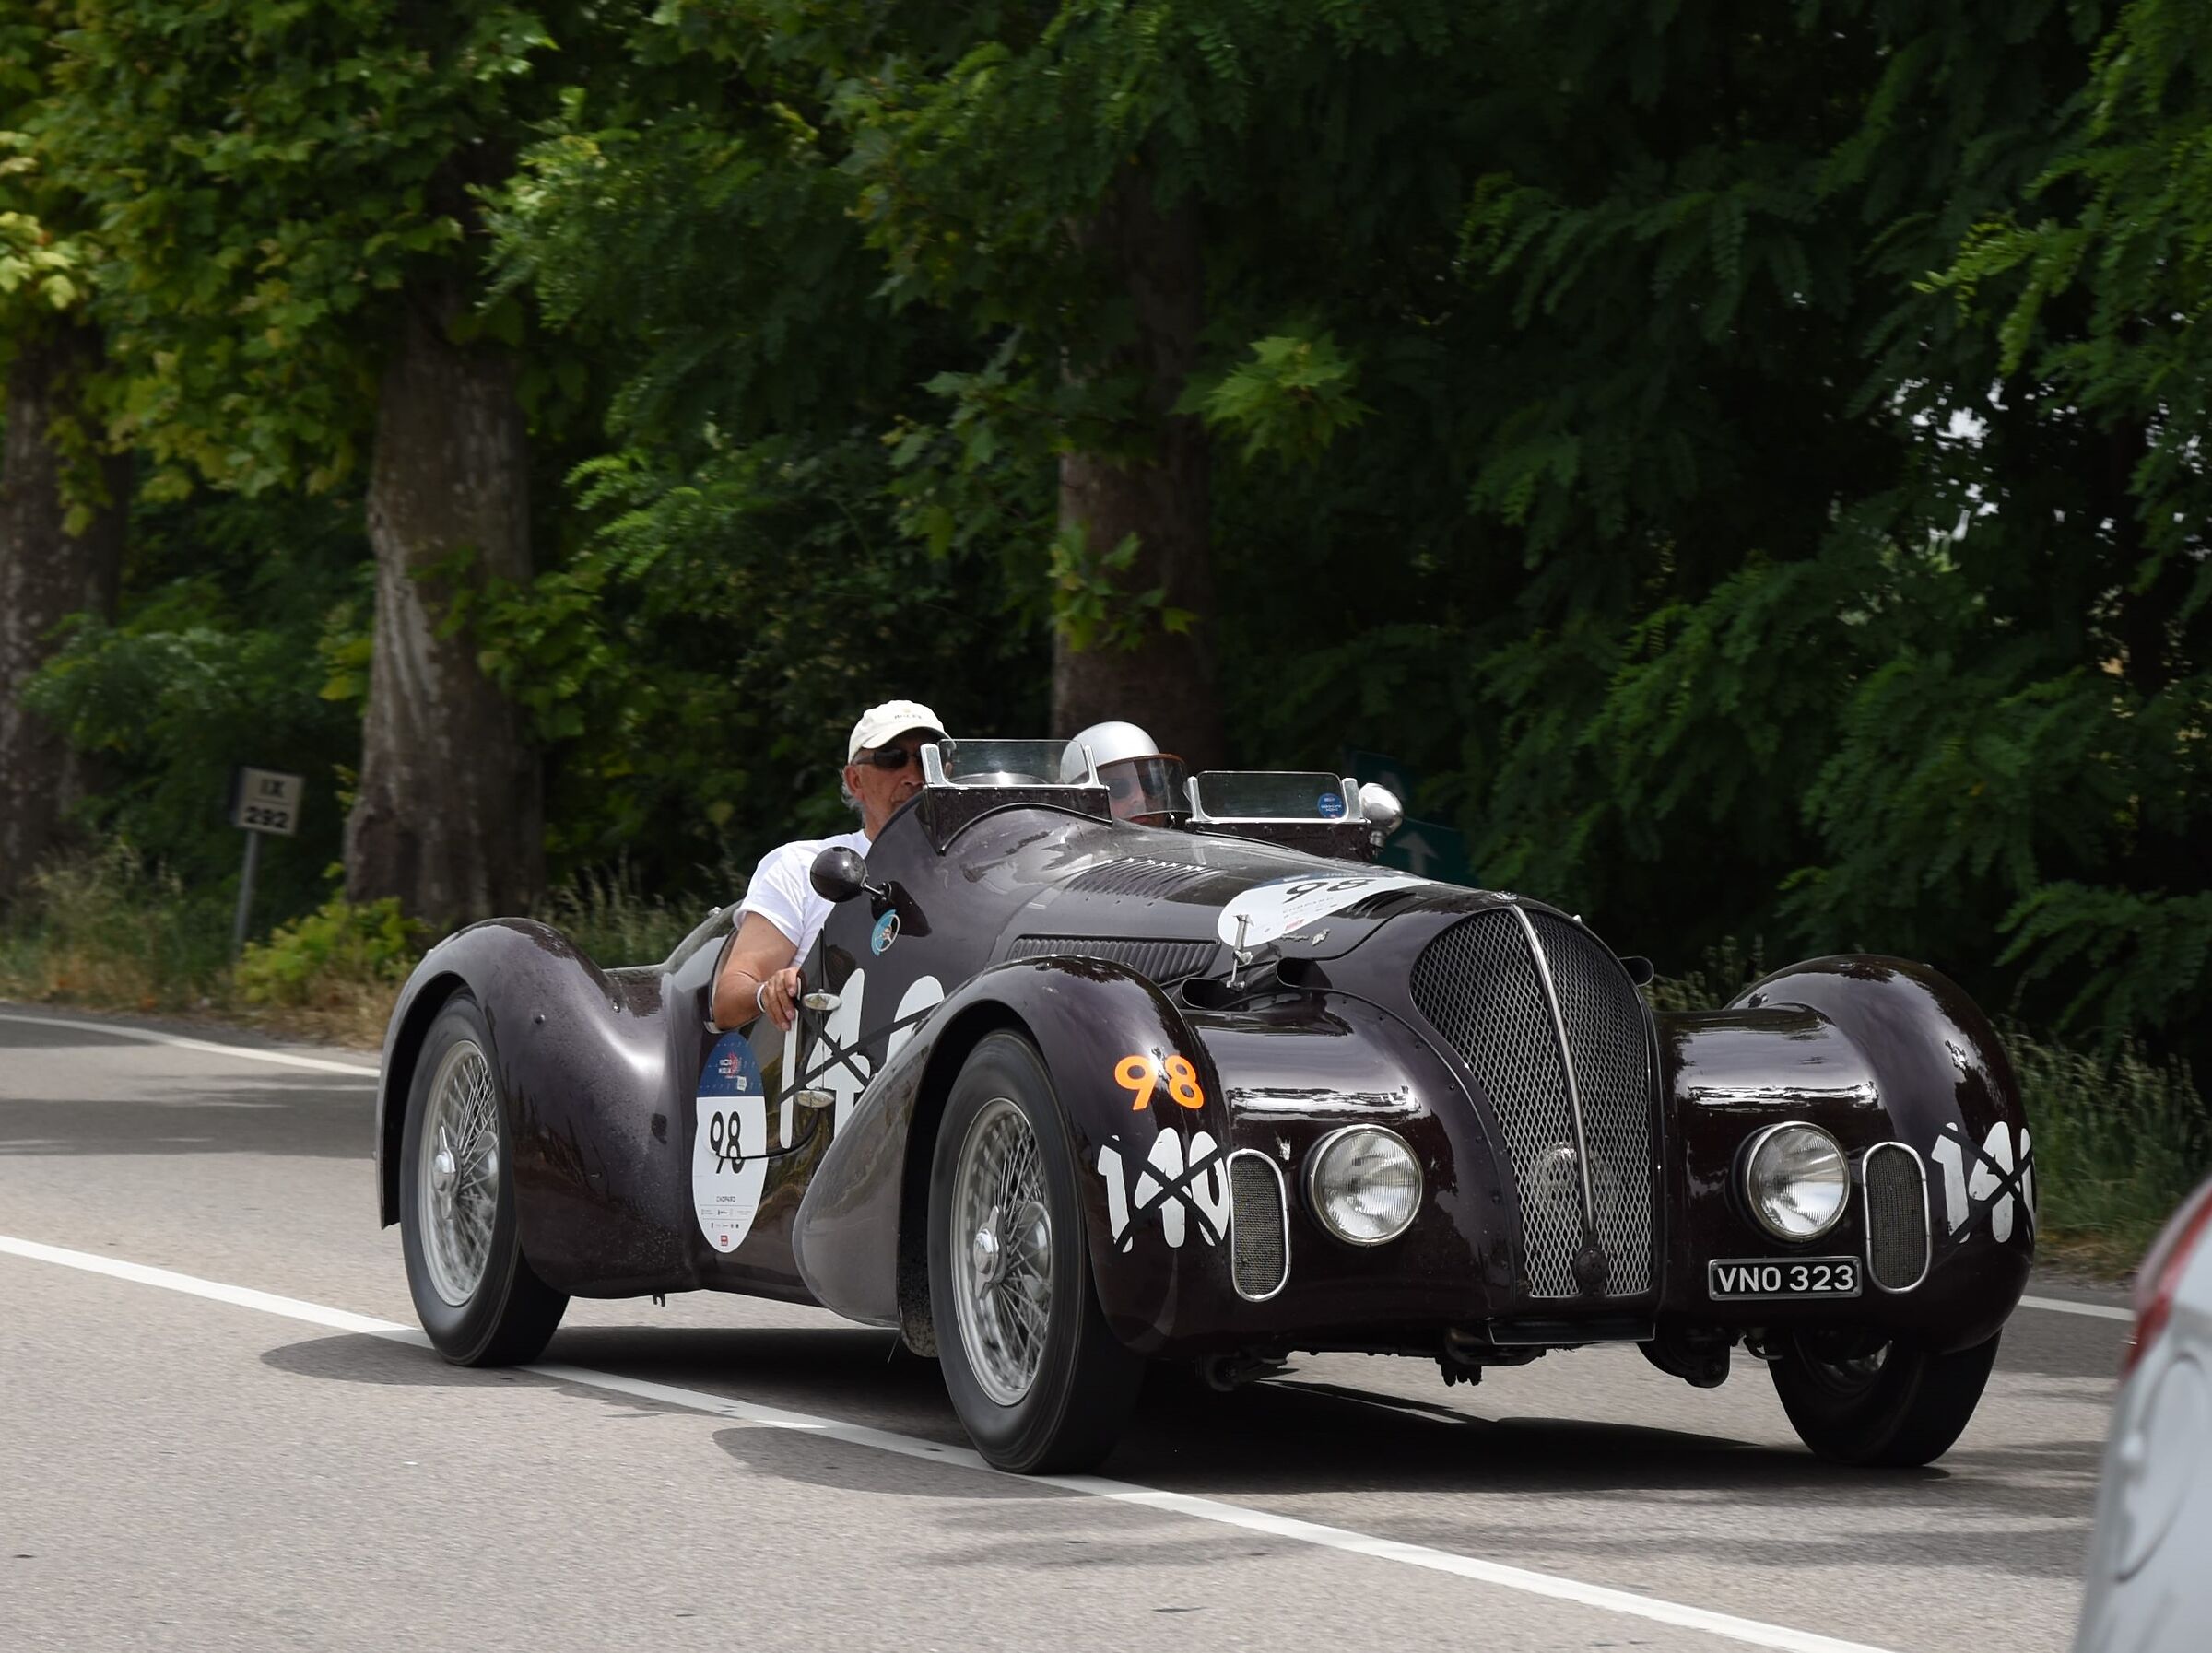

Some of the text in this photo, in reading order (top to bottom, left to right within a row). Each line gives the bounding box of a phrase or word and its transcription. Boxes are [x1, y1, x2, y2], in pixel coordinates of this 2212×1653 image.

[1282, 878, 1376, 904] 98
[1114, 1055, 1205, 1111] 98
[710, 1111, 745, 1174] 98
[1718, 1265, 1853, 1292] VNO 323
